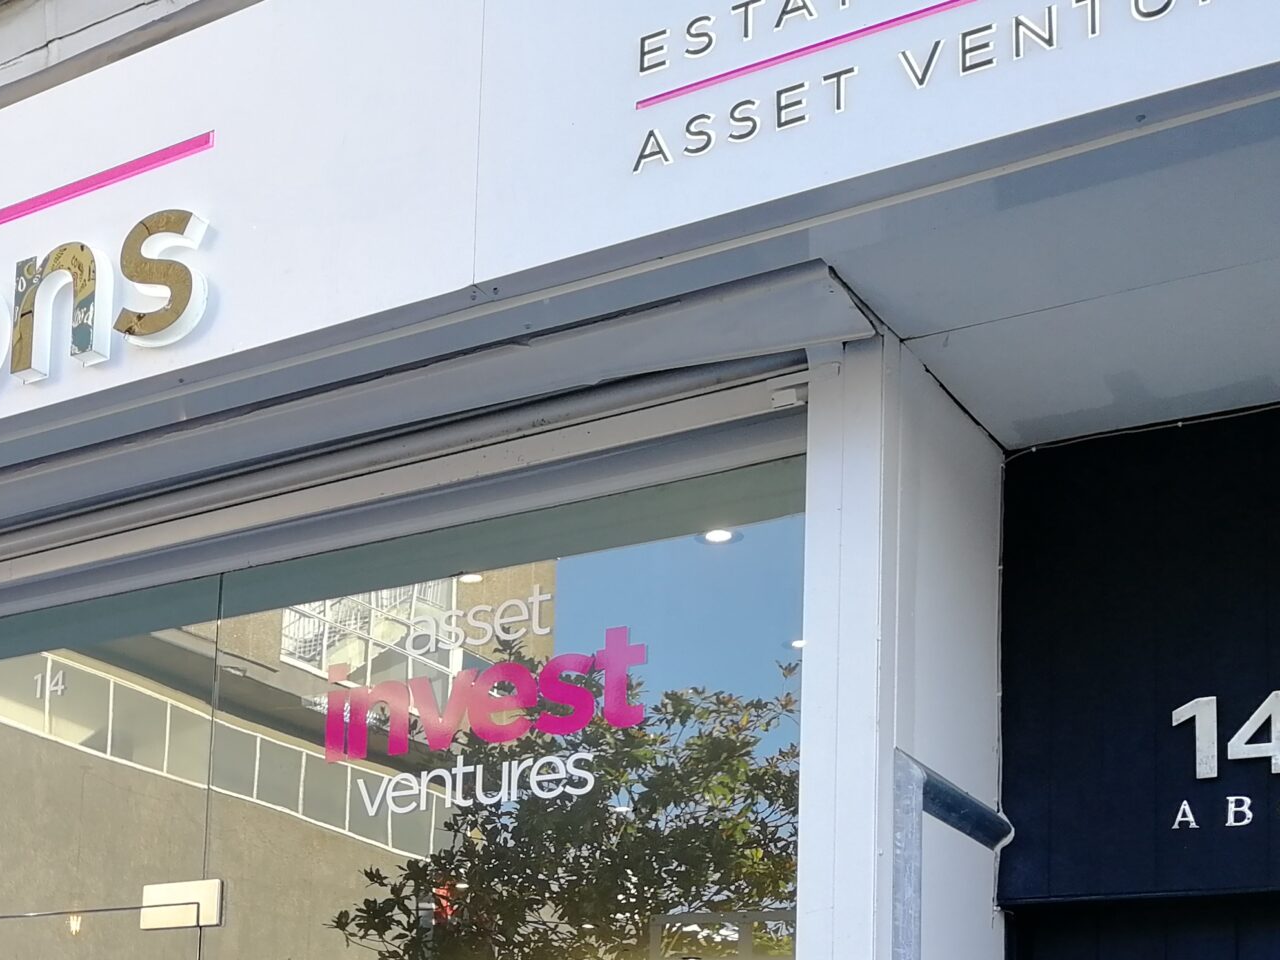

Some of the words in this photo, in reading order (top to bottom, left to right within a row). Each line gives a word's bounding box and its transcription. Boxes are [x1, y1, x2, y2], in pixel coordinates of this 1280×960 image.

[639, 0, 848, 74] ESTA
[632, 66, 858, 174] ASSET
[404, 583, 553, 656] asset
[324, 625, 649, 763] invest
[1172, 690, 1280, 779] 14
[356, 751, 596, 817] ventures
[1171, 799, 1200, 829] A
[1225, 795, 1253, 826] B
